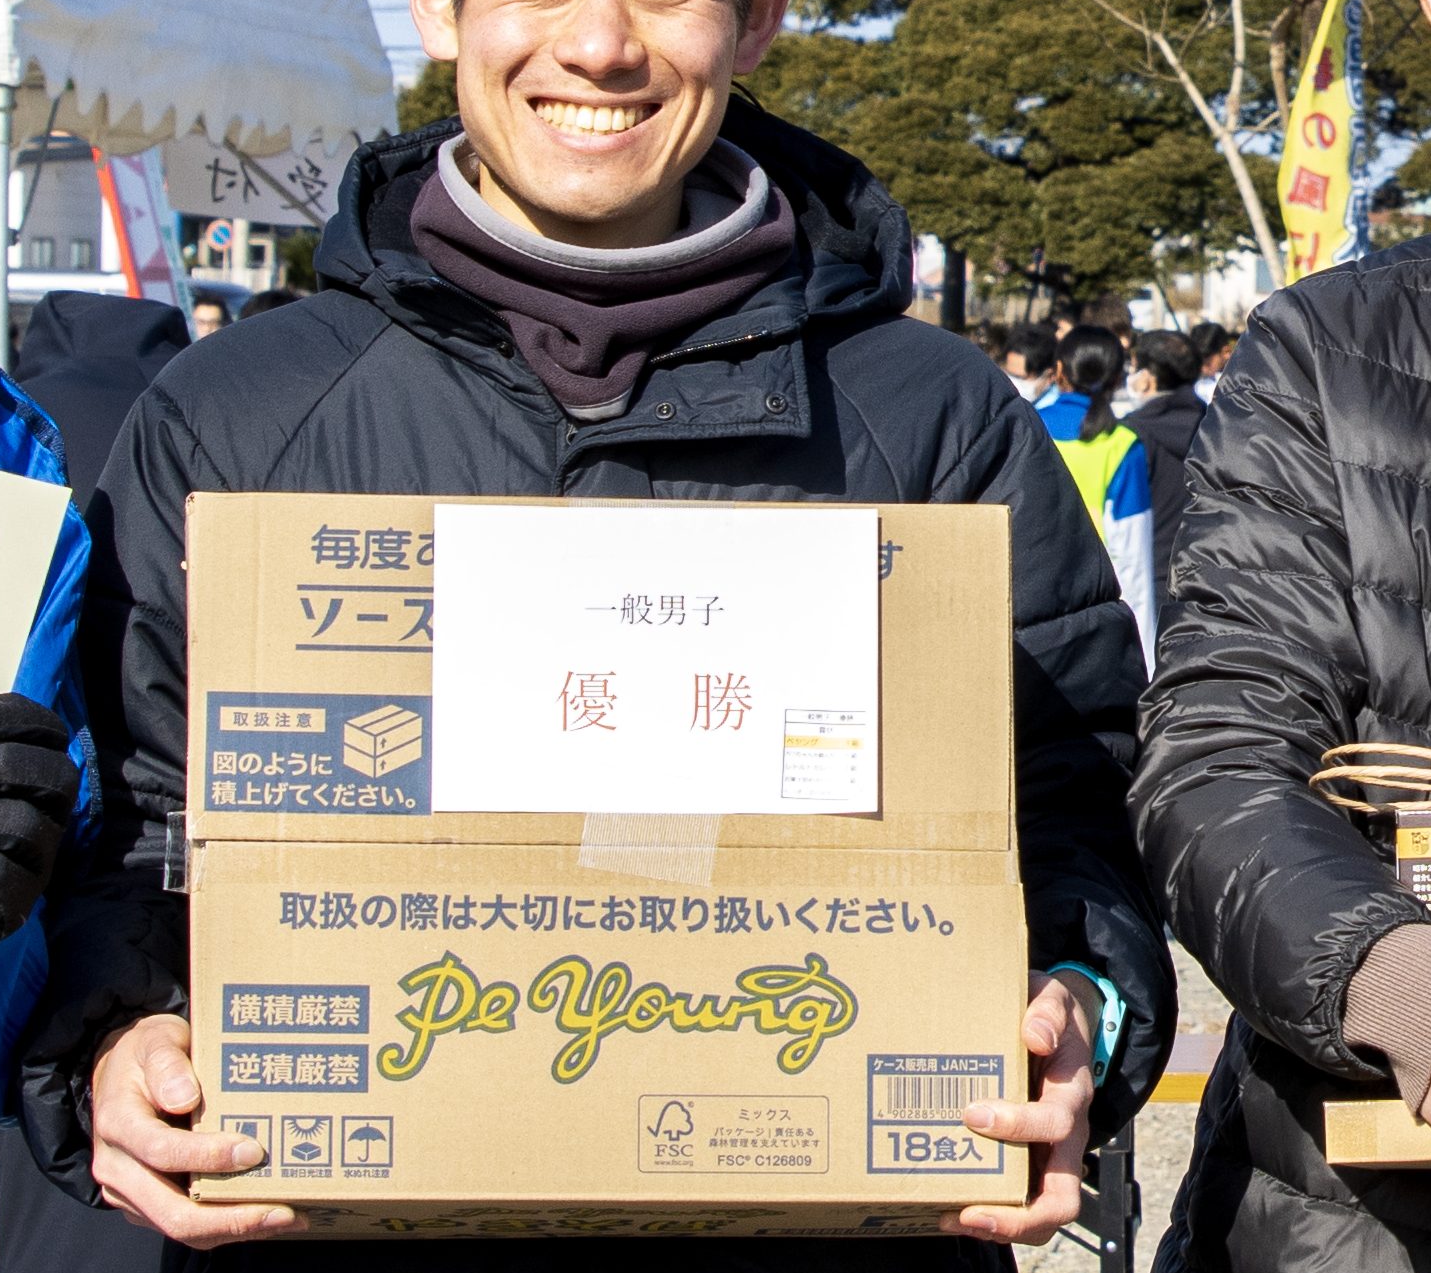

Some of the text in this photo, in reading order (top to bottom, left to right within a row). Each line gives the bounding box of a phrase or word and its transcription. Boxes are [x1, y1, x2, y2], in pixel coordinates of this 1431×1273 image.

[585, 593, 724, 627] 一般男子
[232, 711, 312, 729] 取扱注意
[212, 751, 333, 776] 図のように
[211, 780, 417, 809] 積上げてください。
[278, 890, 956, 936] 取扱の際は大切にお取り扱いください。
[230, 993, 361, 1026] 横積厳禁
[376, 949, 858, 1085] Pe Young
[228, 1053, 360, 1086] 逆積厳禁
[873, 1058, 998, 1072] ケース販売用 JANコード
[739, 1109, 792, 1121] ミックス
[654, 1144, 694, 1157] FSC
[755, 1155, 812, 1166] C126809
[888, 1132, 983, 1162] 18食入
[343, 1168, 390, 1178] 水ぬれ注意
